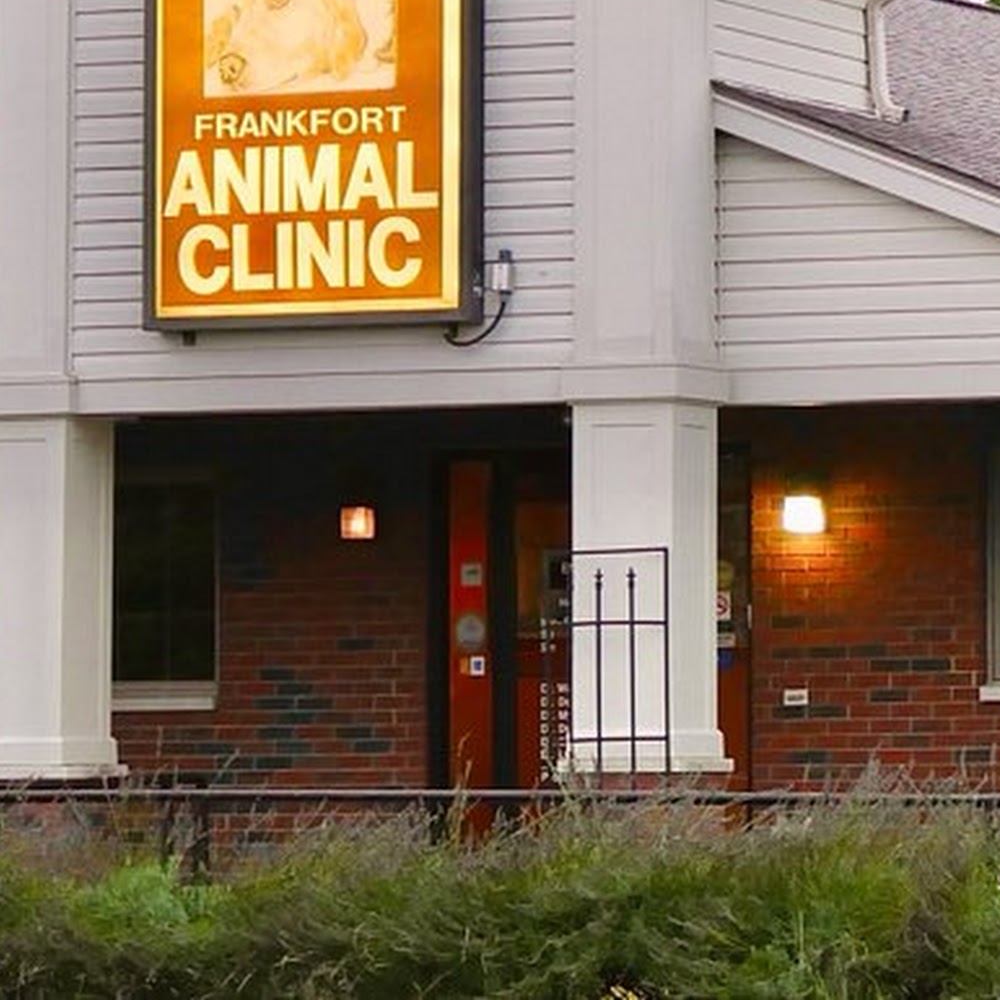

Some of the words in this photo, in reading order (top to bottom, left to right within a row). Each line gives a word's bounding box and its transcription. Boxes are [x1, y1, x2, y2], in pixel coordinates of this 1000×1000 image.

[194, 105, 406, 140] FRANKFORT
[163, 141, 439, 217] ANIMAL
[178, 216, 422, 295] CLINIC
